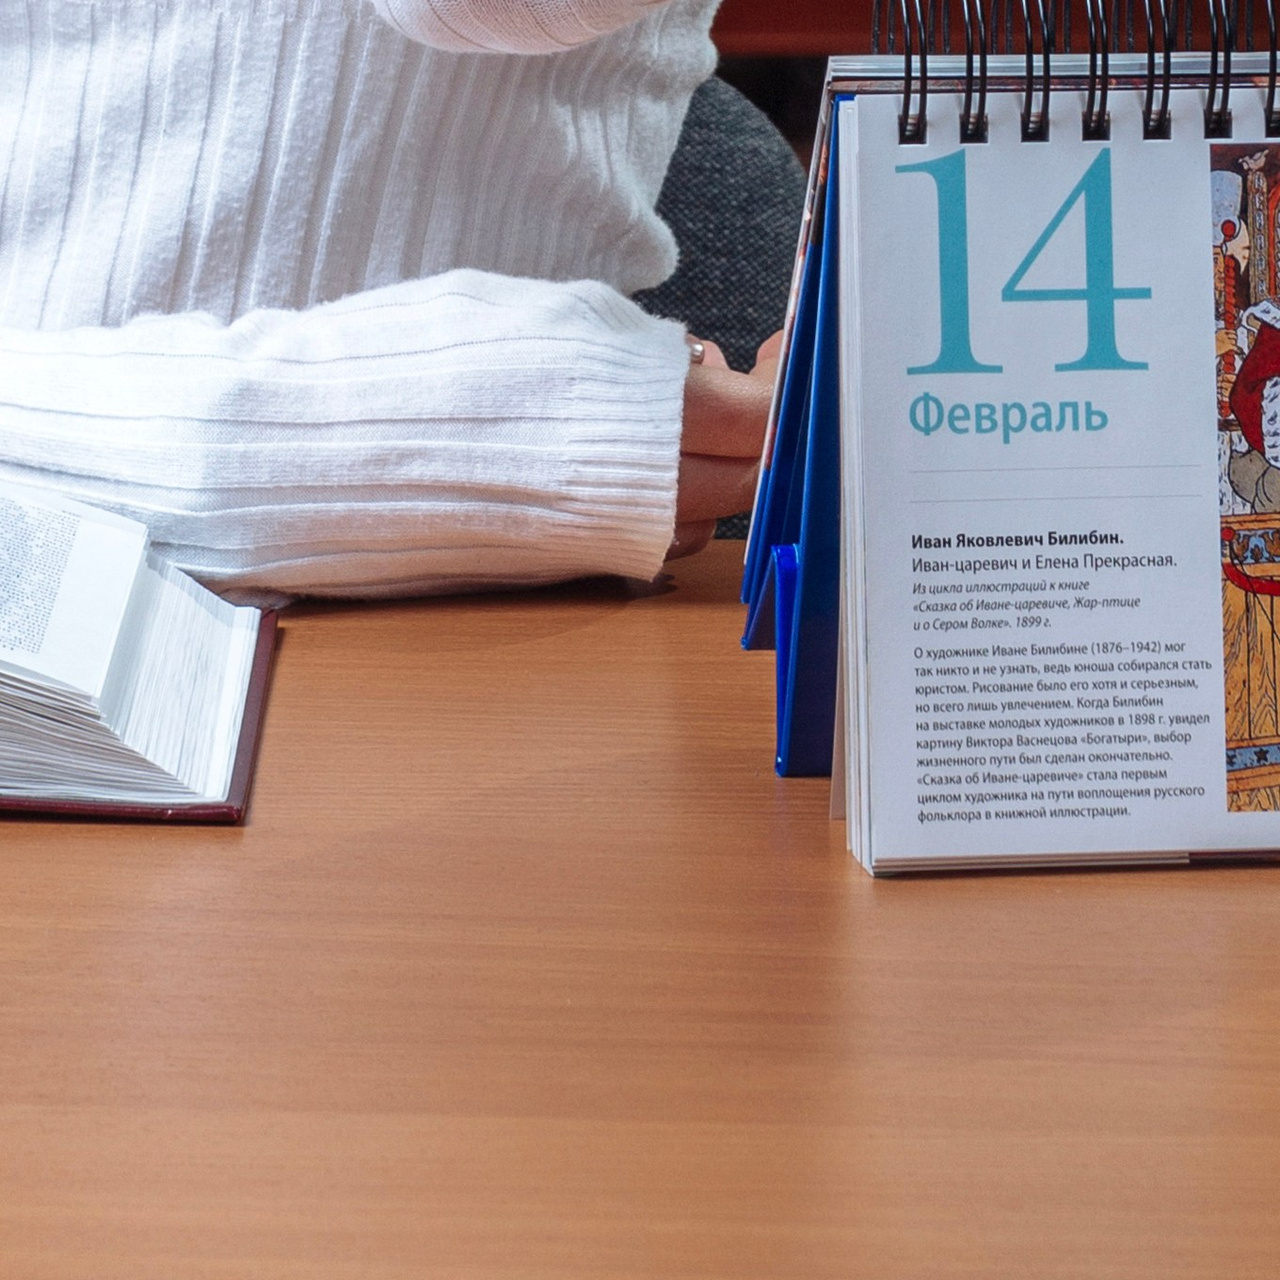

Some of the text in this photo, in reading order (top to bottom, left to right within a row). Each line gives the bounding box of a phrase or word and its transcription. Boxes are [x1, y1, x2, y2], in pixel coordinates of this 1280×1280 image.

[895, 147, 1152, 375] 14
[910, 392, 1108, 444] Февраль
[912, 530, 1123, 549] Иван Яковлевич Билибин.
[913, 553, 1177, 574] Иван-царевич и Елена Прекрасная.
[913, 580, 1089, 595] Из цикла иллюстраций к книге
[959, 599, 973, 611] об
[1073, 597, 1140, 610] Жар-птице
[914, 622, 920, 631] и
[923, 621, 930, 631] о
[933, 618, 968, 632] Сером
[1017, 616, 1042, 628] 1899
[1044, 618, 1051, 627] г.
[914, 647, 923, 659] О
[926, 648, 989, 661] художнике
[992, 645, 1027, 656] Иване
[1031, 643, 1088, 655] Билибине
[1165, 643, 1185, 652] мог
[915, 668, 933, 677] так
[936, 667, 969, 676] никто
[973, 667, 979, 675] и
[983, 666, 997, 675] не
[1044, 664, 1071, 674] ведь
[1074, 663, 1114, 672] юноша
[1118, 659, 1178, 673] собирался
[1182, 661, 1212, 670] стать
[915, 685, 969, 697] юристом.
[973, 682, 1033, 693] Рисование
[1037, 679, 1067, 691] было
[1070, 681, 1089, 691] его
[1092, 681, 1117, 690] хотя
[1120, 681, 1127, 689] и
[916, 695, 1163, 713] но всего лишь увлечением. Когда Билибин
[916, 713, 1210, 731] на выставке молодых художников в 1898 г. увидел
[917, 740, 963, 752] картину
[966, 736, 1013, 749] Виктора
[1017, 734, 1077, 747] Васнецова
[1154, 730, 1191, 745] выбор
[917, 752, 1173, 768] жизненного пути был сделан окончательно.
[965, 772, 979, 784] об
[1087, 771, 1117, 781] стала
[1121, 770, 1167, 782] первым
[918, 787, 1205, 805] циклом художника на пути воплощения русского
[918, 807, 1131, 824] фольклора в книжной иллюстрации.
